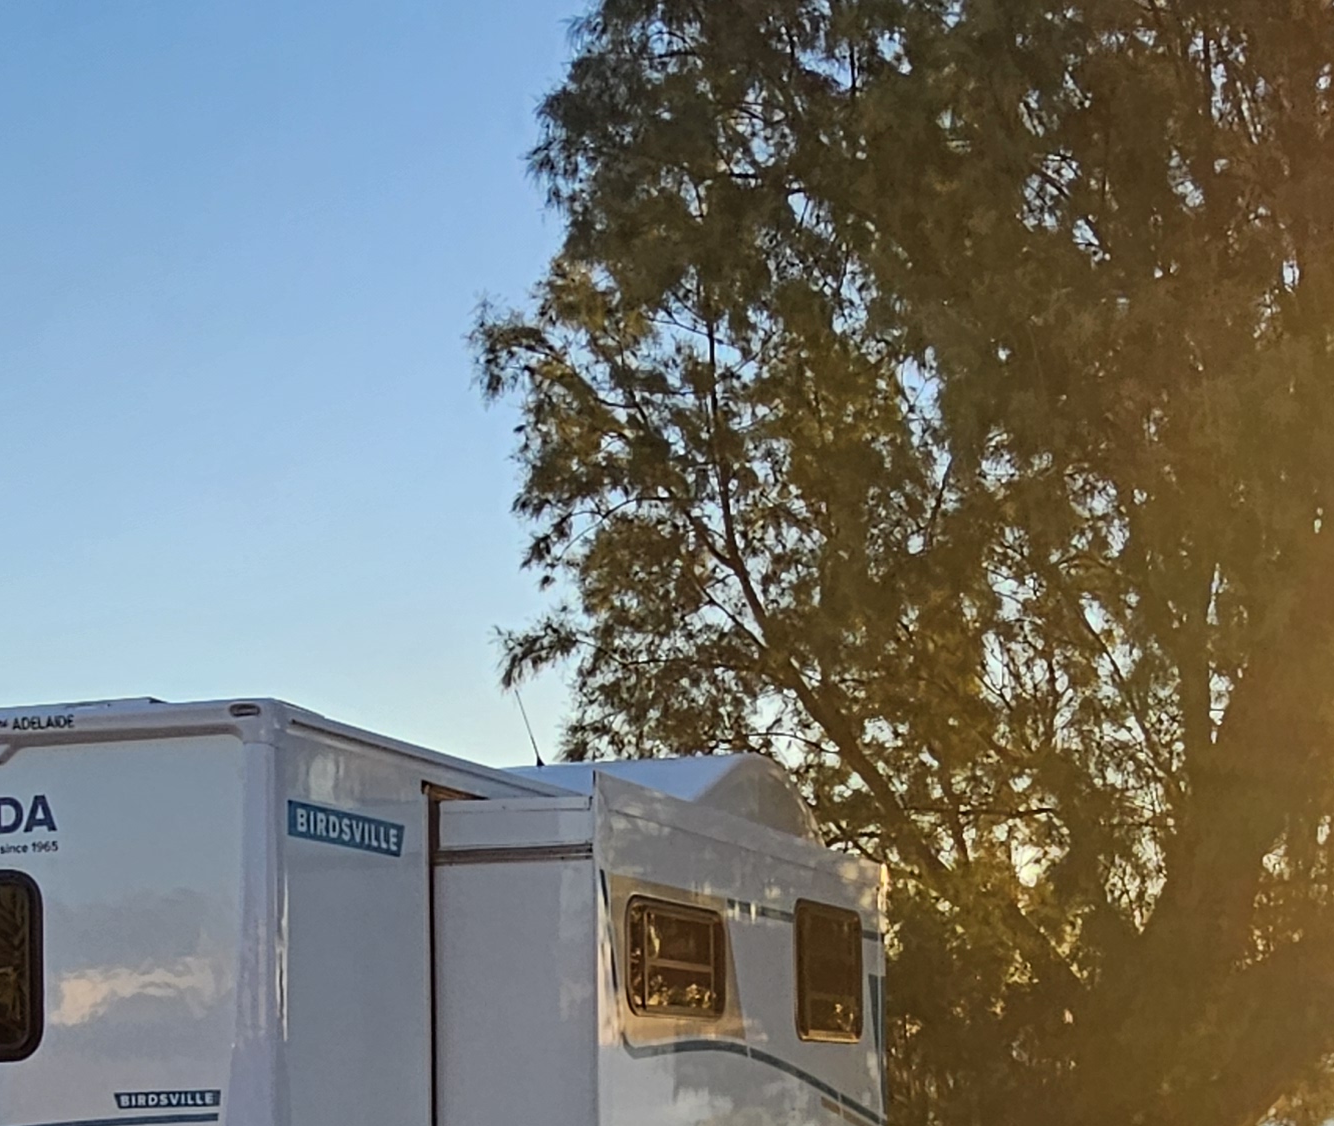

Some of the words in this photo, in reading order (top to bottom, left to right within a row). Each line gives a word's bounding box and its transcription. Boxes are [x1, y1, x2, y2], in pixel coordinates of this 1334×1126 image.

[11, 714, 75, 730] ADELAIDE
[296, 808, 399, 851] BIRDSVILLE
[0, 842, 29, 855] since
[31, 841, 59, 853] 1965
[120, 1092, 214, 1107] BIRDSVILLE
